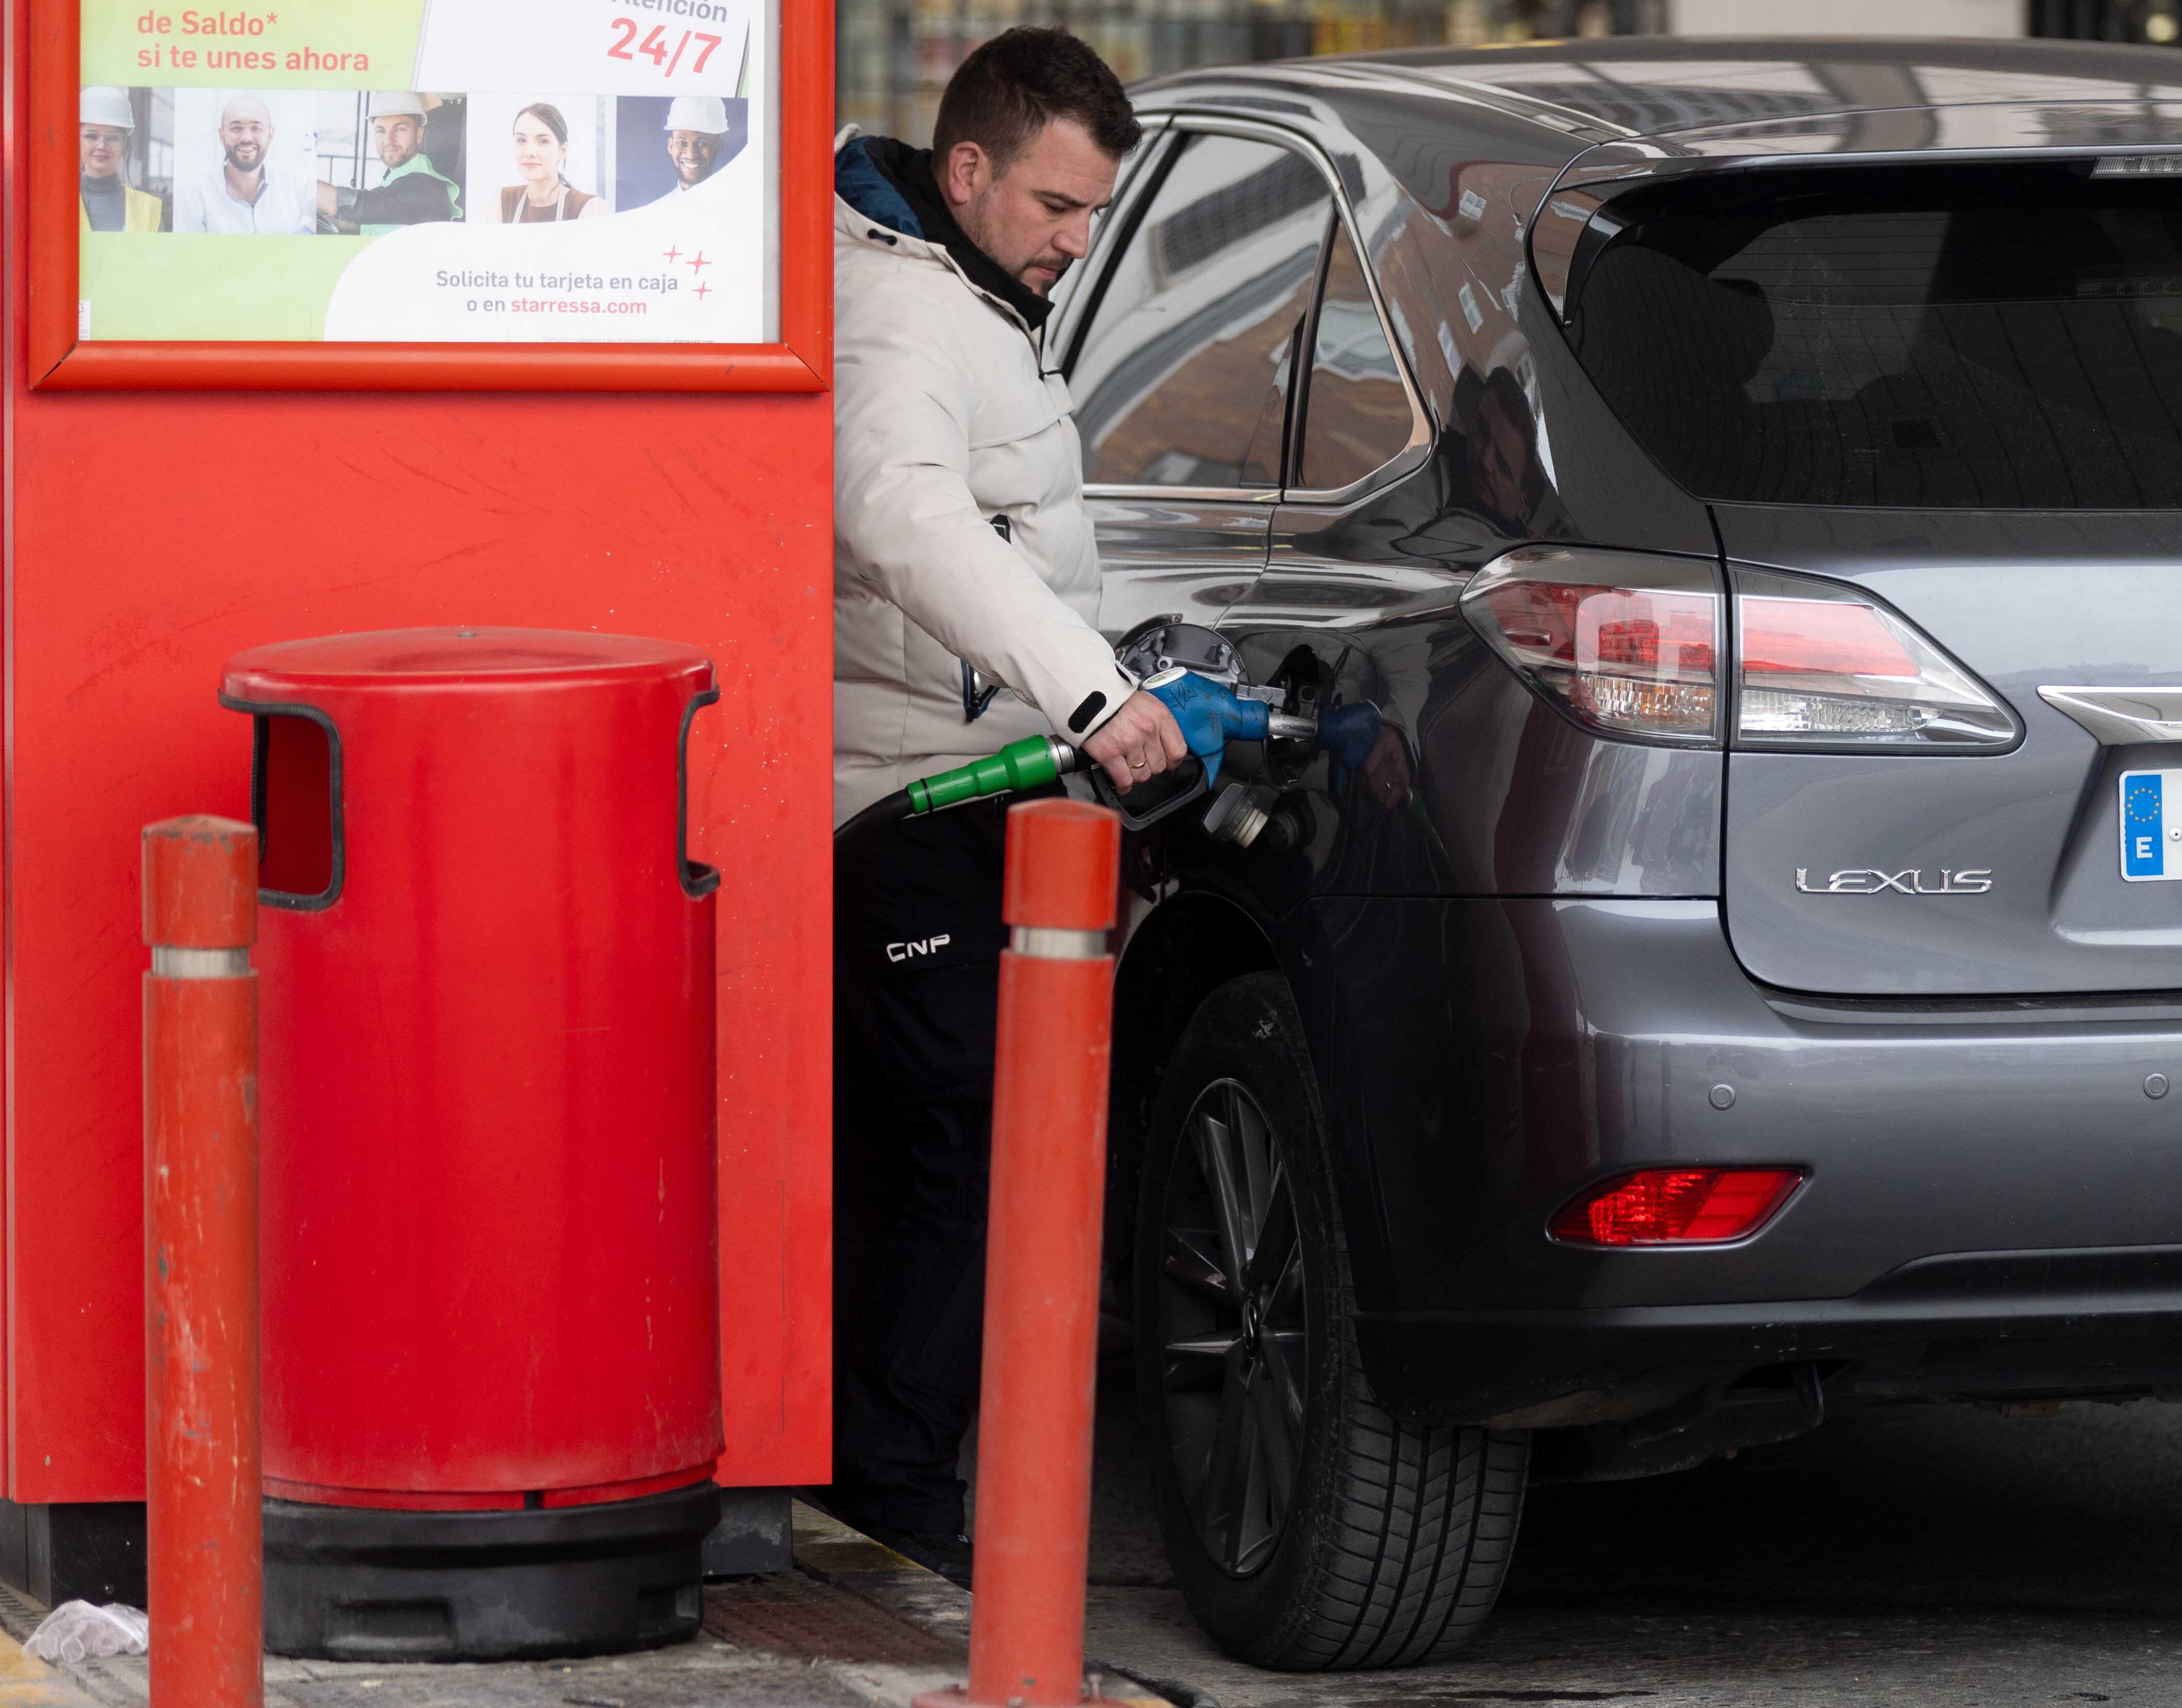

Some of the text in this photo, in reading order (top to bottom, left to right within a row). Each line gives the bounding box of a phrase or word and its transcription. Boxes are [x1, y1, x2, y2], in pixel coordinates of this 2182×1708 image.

[137, 9, 172, 34] de
[611, 0, 727, 23] ención
[137, 43, 370, 72] si te unes ahora
[607, 18, 723, 78] 24/7
[436, 271, 678, 294] Solicita tu tarjeta en caja
[467, 297, 647, 314] o en starressa.com
[2136, 836, 2153, 858] E
[1796, 868, 1992, 894] LEXUS
[886, 934, 951, 963] CNP
